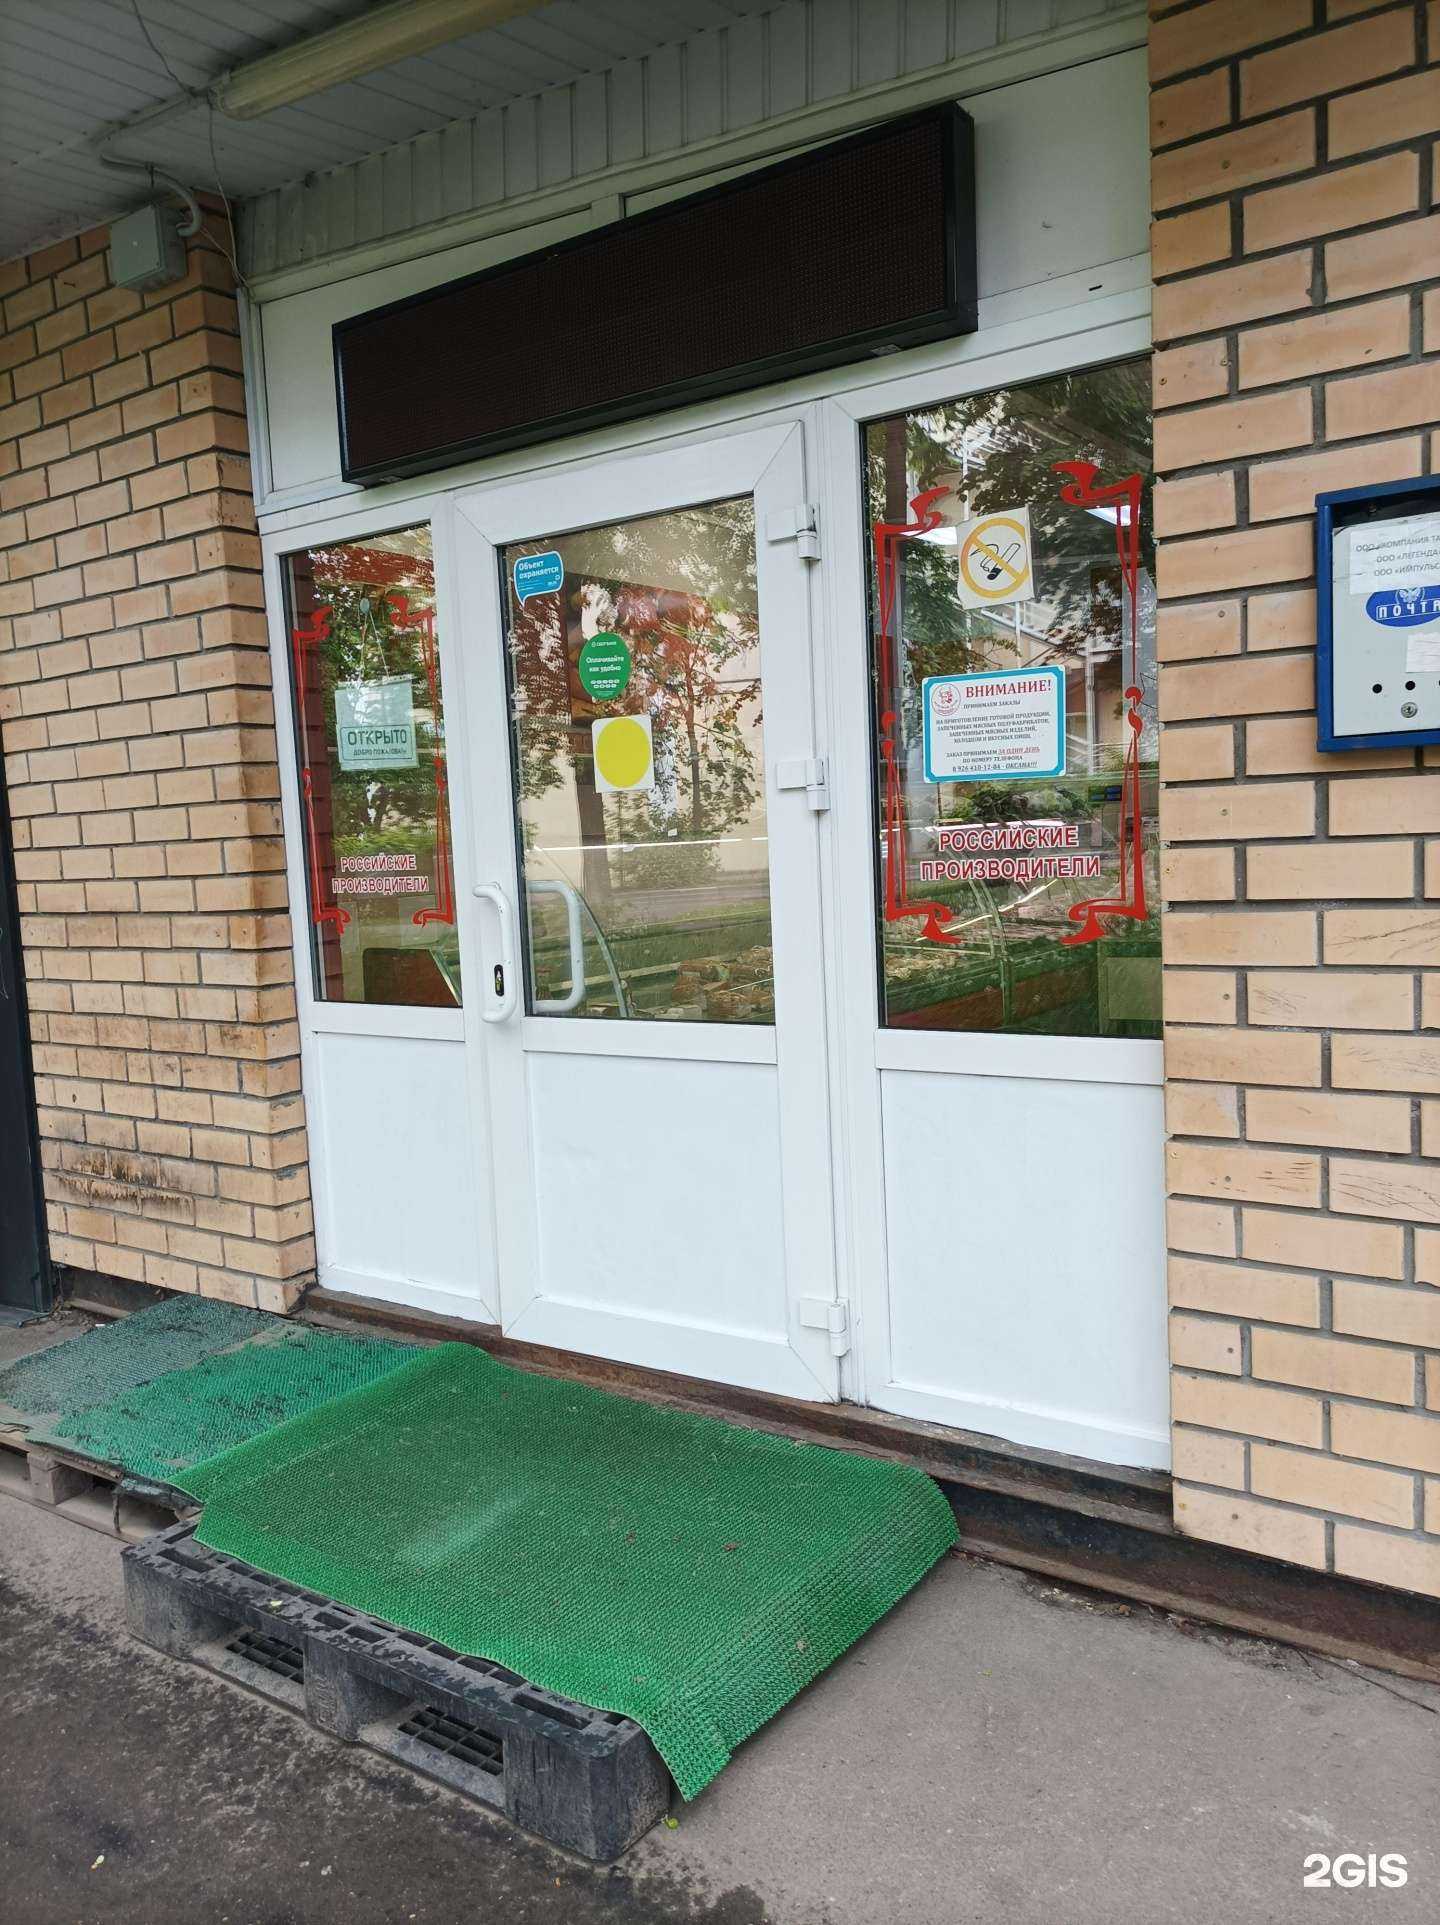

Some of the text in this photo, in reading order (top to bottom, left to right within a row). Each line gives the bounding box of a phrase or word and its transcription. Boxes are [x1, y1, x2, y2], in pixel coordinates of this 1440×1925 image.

[518, 560, 544, 570] Объект
[1377, 554, 1395, 563] ООО
[519, 566, 559, 579] охраняется
[1374, 567, 1392, 576] ООО
[966, 679, 1052, 698] ВНИМАНИЕ!
[963, 701, 998, 709] ПРИНИМАЕМ
[347, 729, 407, 746] ОТКРЫТО
[963, 749, 998, 757] ПРИНИМАЕМ
[939, 825, 1079, 851] РОССИЙСКИЕ
[340, 852, 417, 872] РОССИЙСКИЕ
[920, 855, 1101, 882] ПРОИЗВОДИТЕЛИ
[332, 876, 429, 895] ПРОИЗВОДИТЕЛИ
